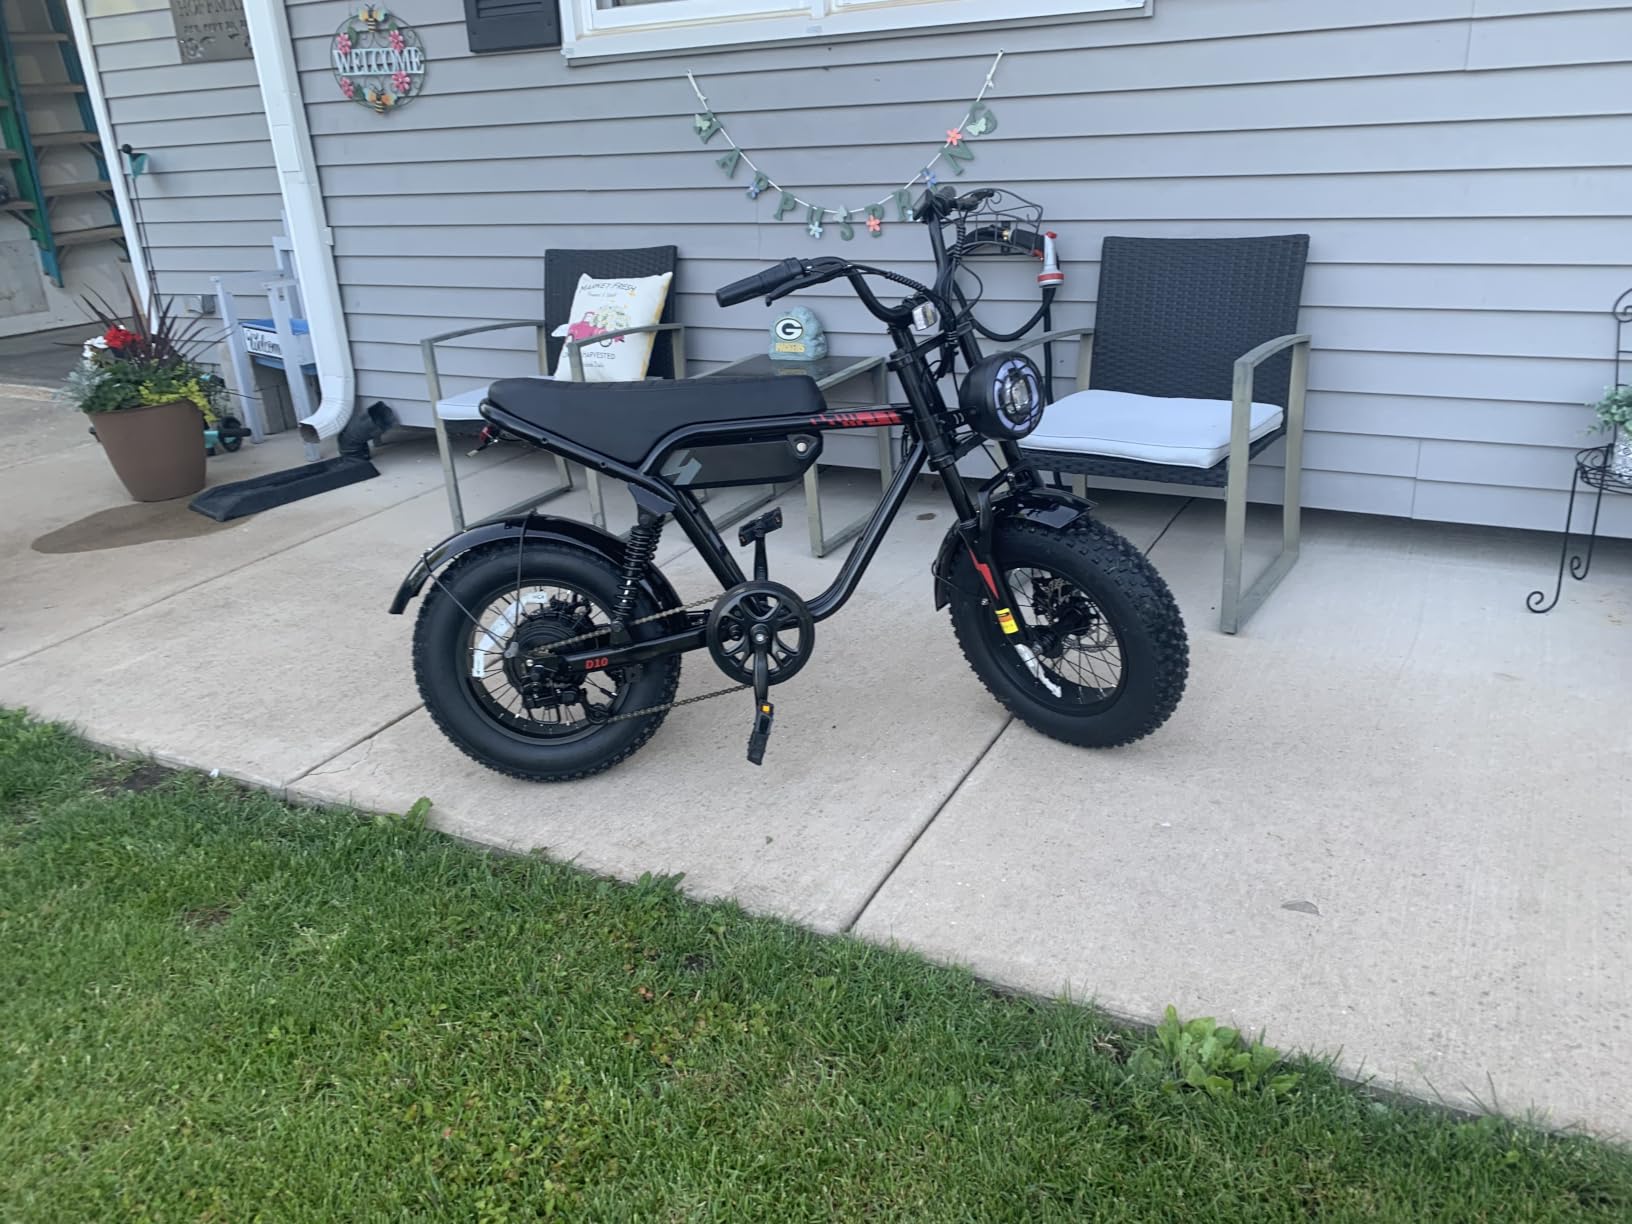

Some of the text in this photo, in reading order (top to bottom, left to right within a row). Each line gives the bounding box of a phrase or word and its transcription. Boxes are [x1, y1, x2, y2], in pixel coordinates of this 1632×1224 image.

[332, 46, 425, 76] WELCOME
[775, 317, 803, 342] G
[584, 656, 609, 669] D10
